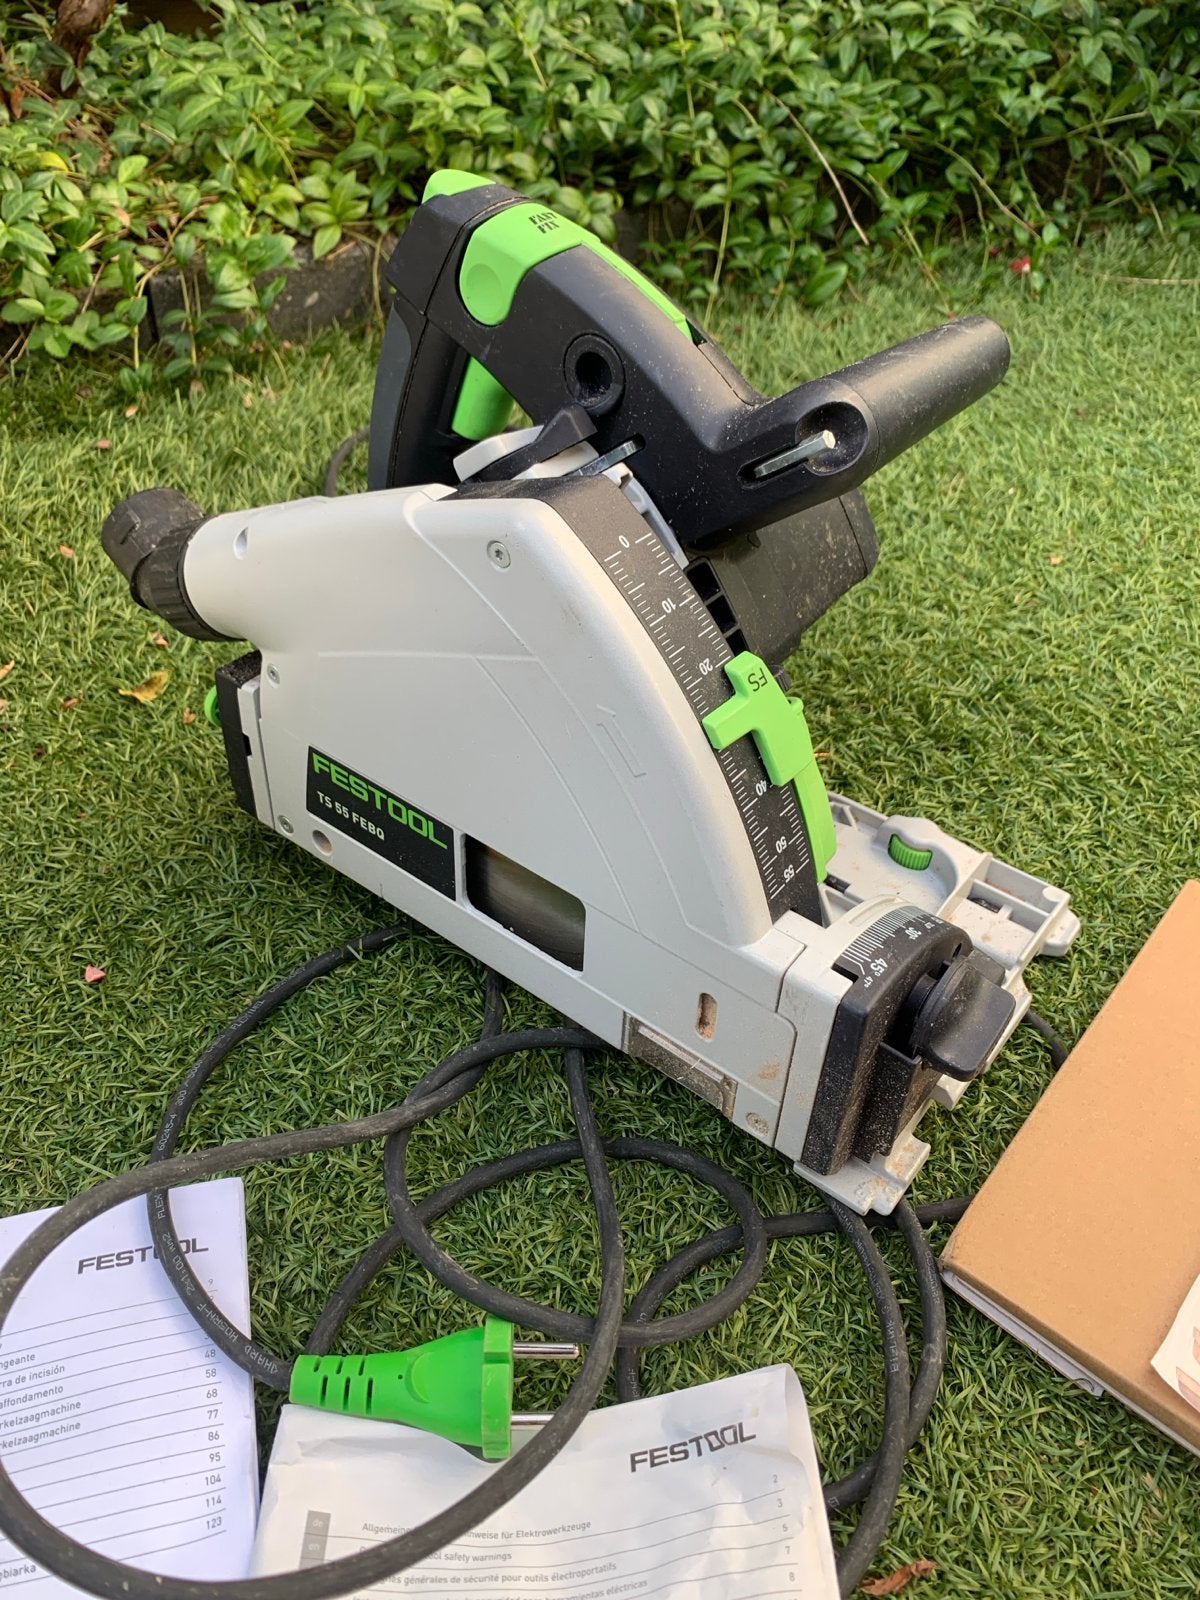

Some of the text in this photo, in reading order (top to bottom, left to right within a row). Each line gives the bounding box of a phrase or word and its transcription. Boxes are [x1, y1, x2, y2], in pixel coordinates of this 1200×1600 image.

[528, 212, 558, 225] FAST
[537, 221, 560, 234] FIX
[618, 535, 630, 548] 0
[661, 597, 676, 614] 10
[698, 657, 713, 676] 20
[747, 667, 769, 692] FS
[755, 780, 767, 797] 40
[312, 752, 448, 850] FESTOOL
[317, 790, 385, 841] TS 55 FEBQ
[775, 836, 788, 854] 50
[783, 864, 795, 883] 55
[77, 1237, 209, 1274] FESTOL
[15, 1375, 26, 1385] de
[29, 1364, 65, 1381] incisión
[205, 1368, 217, 1378] 58
[206, 1389, 218, 1399] 68
[207, 1409, 219, 1419] 77
[208, 1430, 220, 1441] 86
[630, 1422, 756, 1473] FESTOOL
[209, 1452, 221, 1463] 95
[205, 1475, 222, 1486] 104
[205, 1496, 222, 1508] 114
[206, 1517, 222, 1530] 123
[501, 1531, 513, 1539] für
[516, 1521, 591, 1538] Elektrowerkzeuge
[444, 1551, 470, 1563] safety
[472, 1553, 512, 1562] warnings
[404, 1576, 448, 1586] générales
[451, 1576, 462, 1584] de
[464, 1574, 499, 1583] sécurité
[501, 1574, 522, 1584] pour
[524, 1573, 549, 1583] outils
[551, 1562, 617, 1581] électroportatifs
[789, 1572, 795, 1582] 8
[606, 1580, 648, 1595] eléctricas
